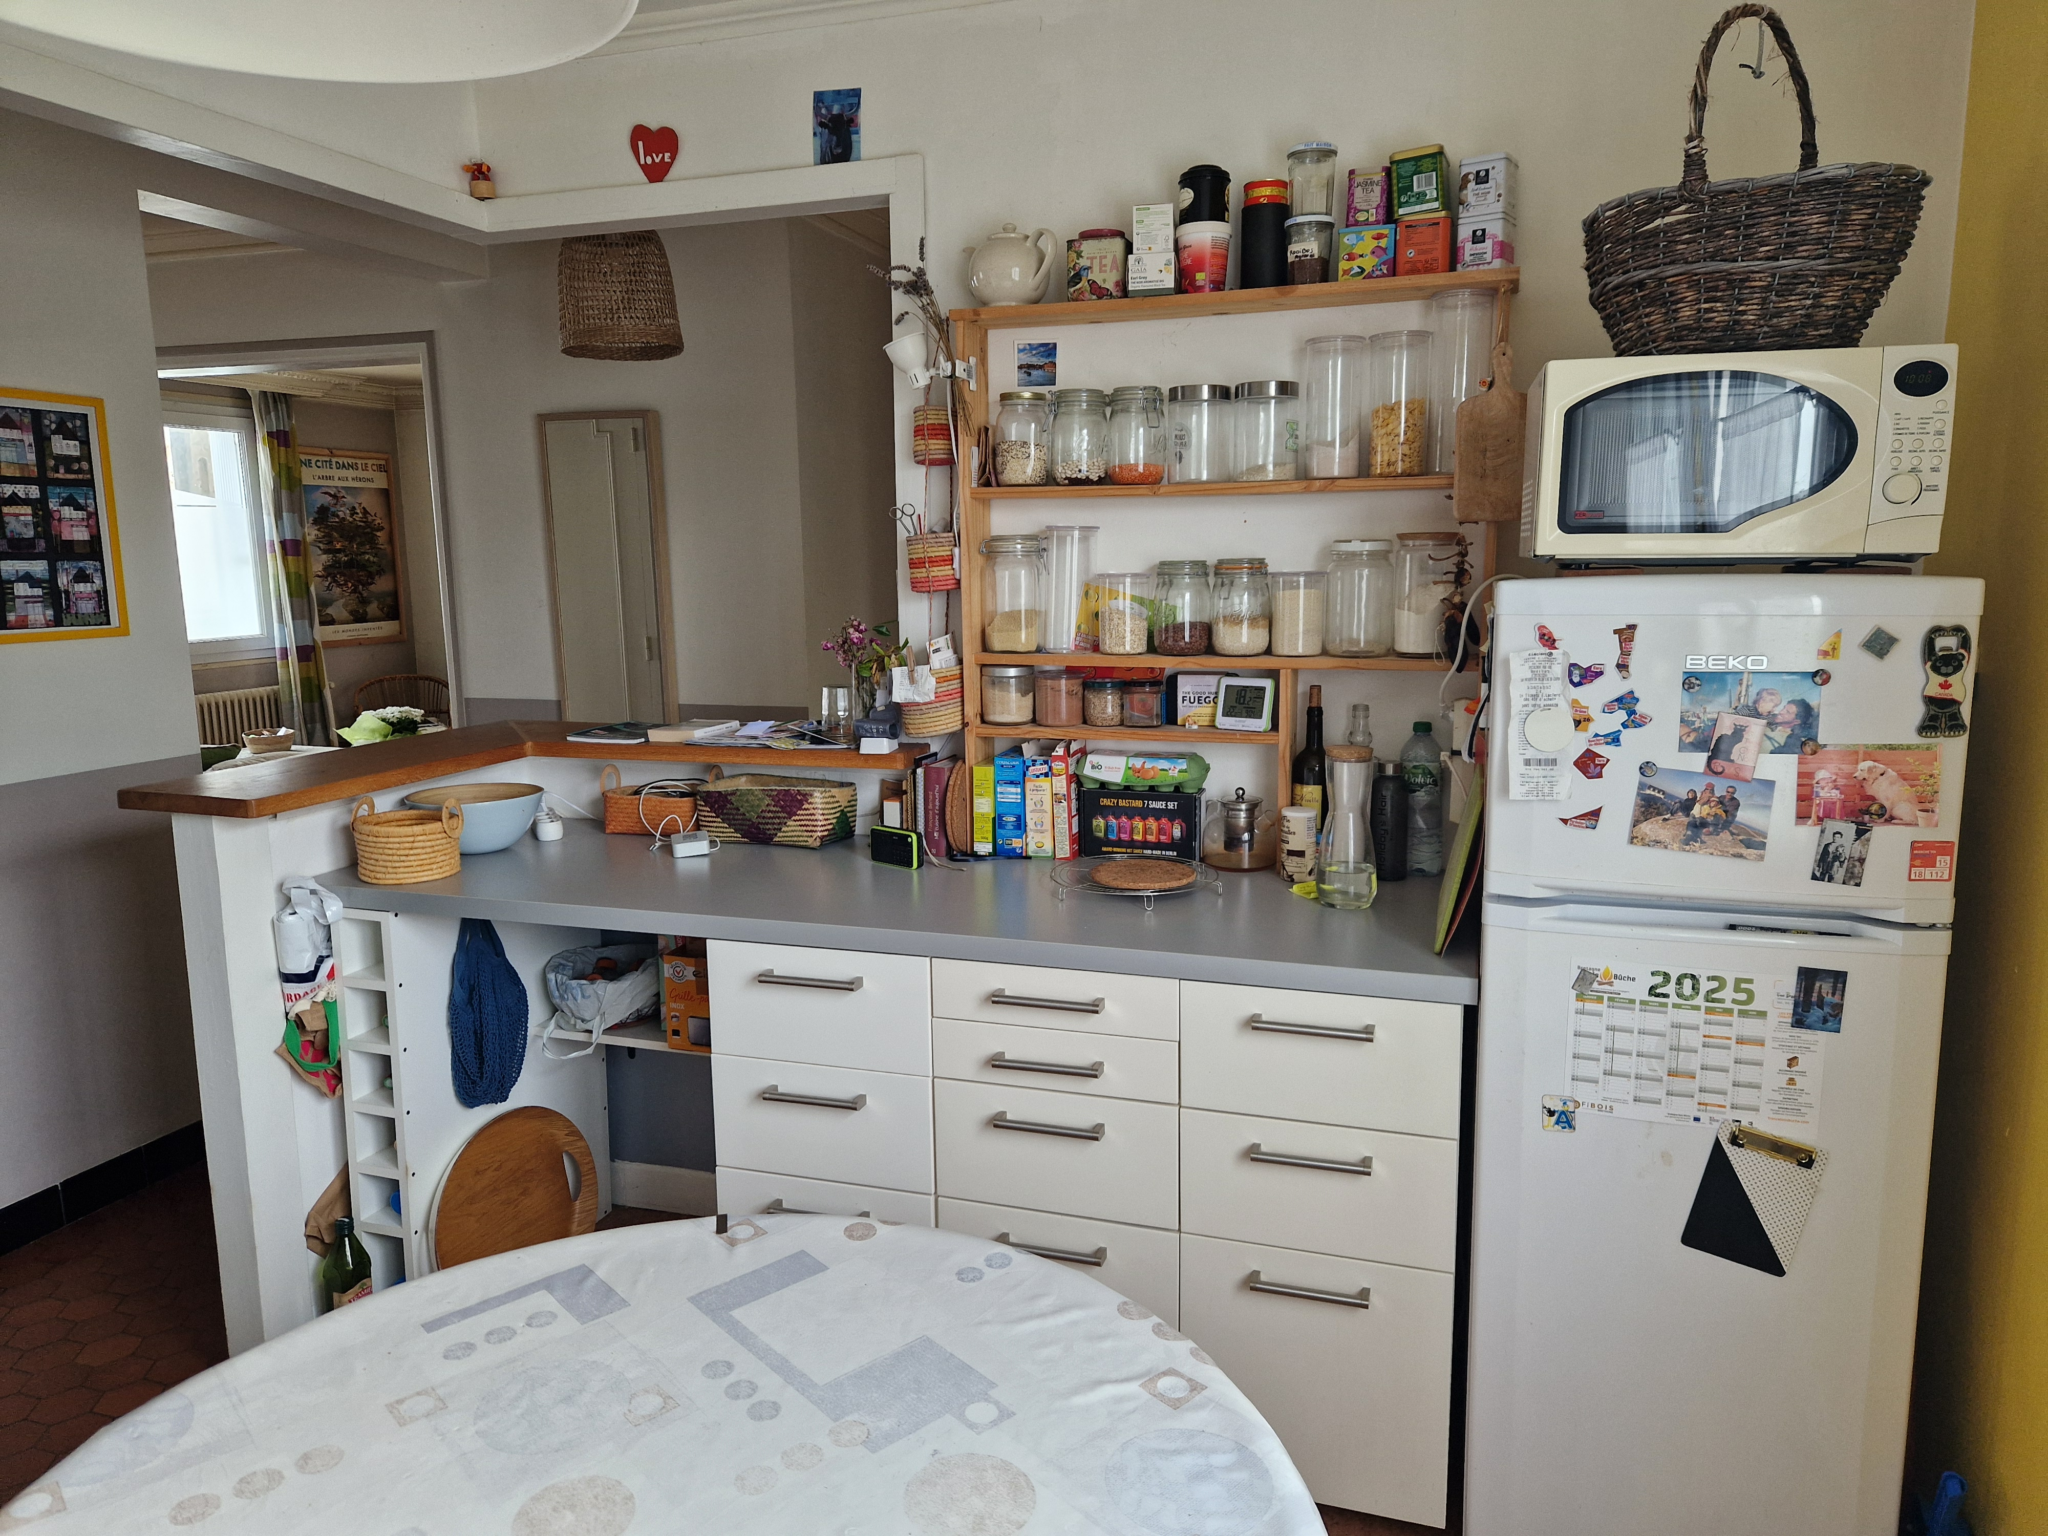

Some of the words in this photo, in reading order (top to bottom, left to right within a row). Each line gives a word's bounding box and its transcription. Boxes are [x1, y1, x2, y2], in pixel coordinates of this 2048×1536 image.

[1354, 179, 1382, 188] JASMINE
[1361, 187, 1375, 195] TEA
[1086, 254, 1120, 275] TEA
[300, 458, 313, 469] NE
[315, 457, 333, 470] CITÉ
[335, 460, 359, 471] DANS
[361, 462, 369, 472] LE
[371, 463, 388, 473] CIEL
[312, 474, 335, 482] L'ARBRE
[1685, 654, 1769, 671] BEKO
[1100, 797, 1118, 807] CRAZY
[1118, 798, 1143, 808] BASTARD
[1144, 800, 1148, 808] 7
[1148, 800, 1167, 809] SAUCE
[1167, 801, 1178, 810] SET
[1377, 792, 1388, 816] Hair
[1938, 859, 1948, 867] 15
[1613, 973, 1637, 982] Bûche
[1647, 969, 1757, 1007] 2025
[669, 1002, 685, 1010] INOX
